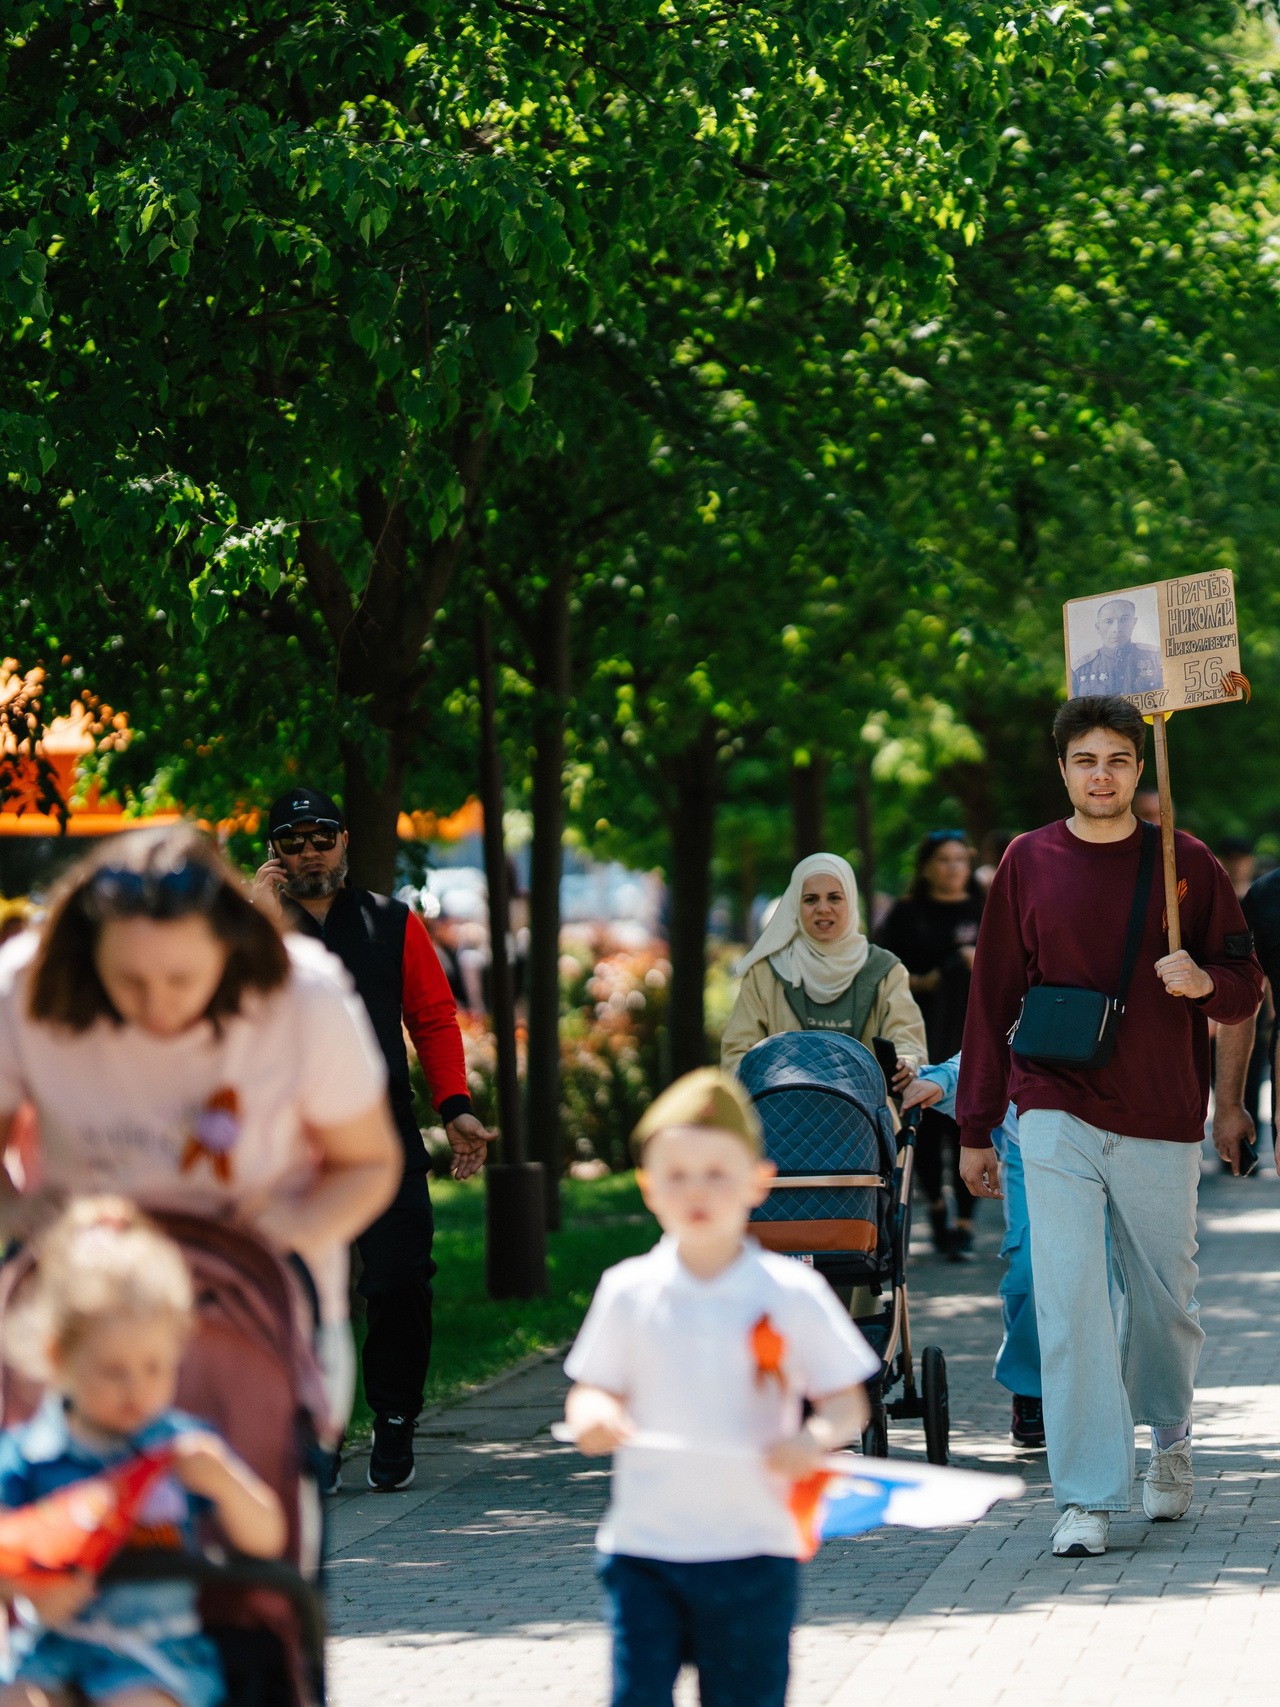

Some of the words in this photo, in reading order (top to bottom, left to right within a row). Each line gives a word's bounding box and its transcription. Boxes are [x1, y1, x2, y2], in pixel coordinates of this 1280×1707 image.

[1166, 573, 1231, 608] ГРАЧЁВ
[1167, 598, 1235, 637] НИКОЛАЙ
[1165, 633, 1237, 657] НИКОЛАЕВИЧ
[1183, 656, 1223, 693] 56
